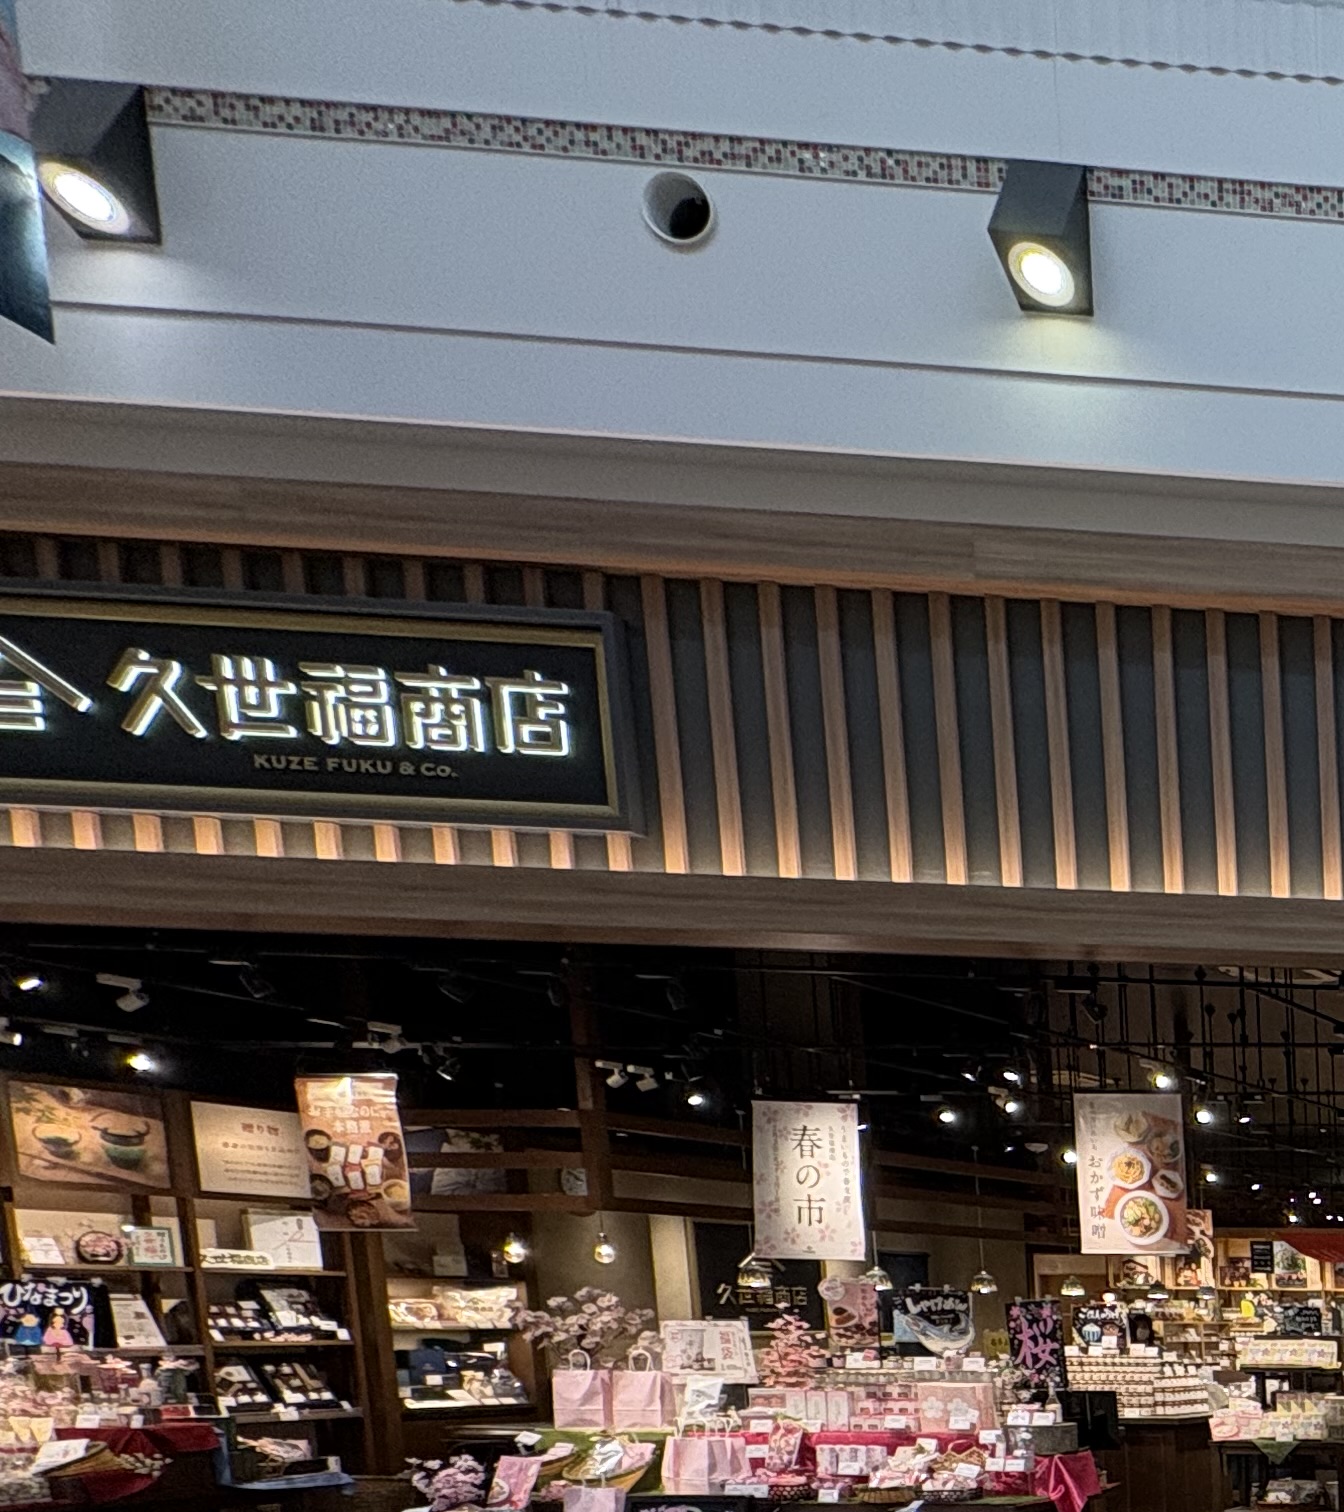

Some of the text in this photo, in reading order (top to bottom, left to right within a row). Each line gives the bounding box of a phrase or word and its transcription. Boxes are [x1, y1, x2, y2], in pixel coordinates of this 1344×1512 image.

[105, 645, 572, 758] 久世福商店
[254, 753, 319, 772] KUZE
[326, 757, 393, 775] FUKU
[400, 761, 415, 776] &
[789, 1124, 827, 1227] 春の市
[0, 1282, 89, 1314] ひなまつり
[1014, 1315, 1060, 1370] 桜
